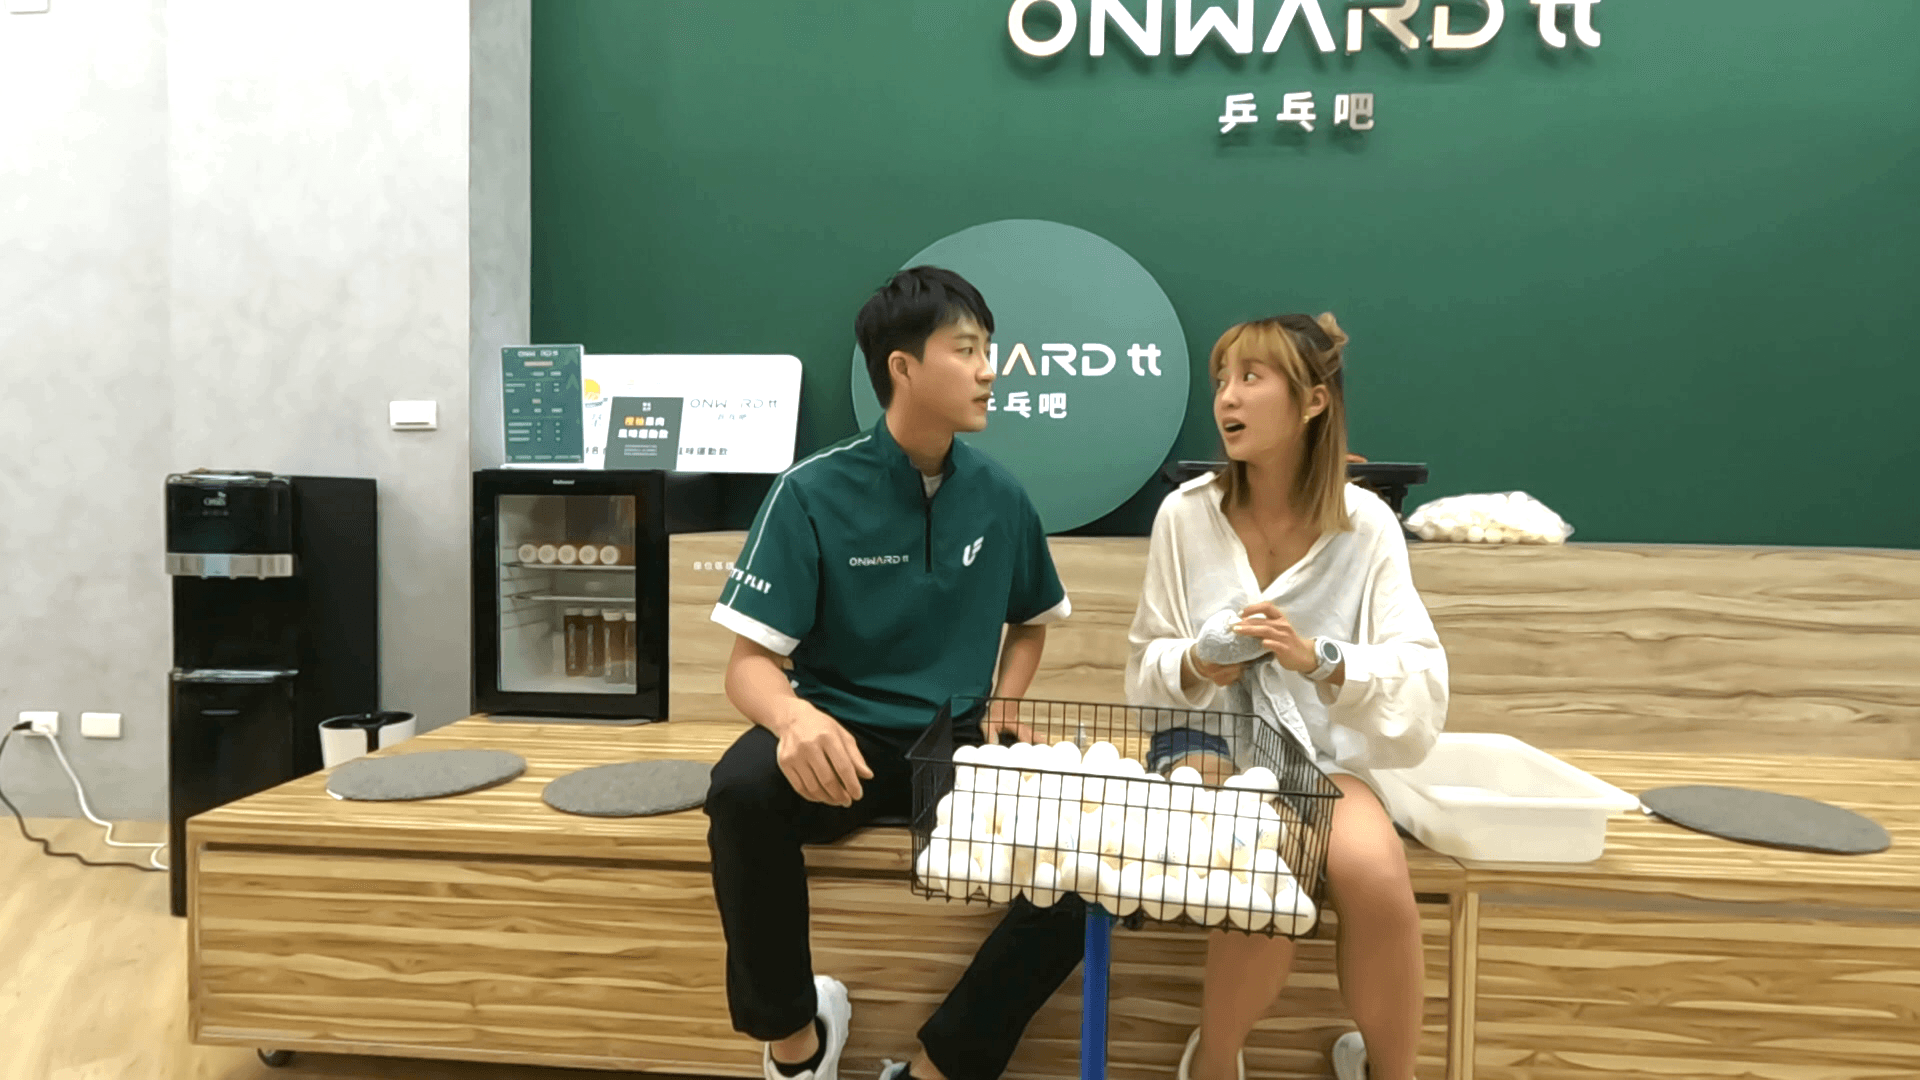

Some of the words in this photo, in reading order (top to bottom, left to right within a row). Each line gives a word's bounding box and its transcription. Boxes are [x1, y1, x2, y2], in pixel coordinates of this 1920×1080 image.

[1007, 0, 1505, 56] ONWARD
[1219, 91, 1375, 134] 乒乓吧
[989, 342, 1117, 376] ARD
[1126, 342, 1162, 376] tt
[689, 398, 764, 409] ONWRD
[848, 555, 901, 567] ONWARD
[744, 573, 772, 595] PLAY
